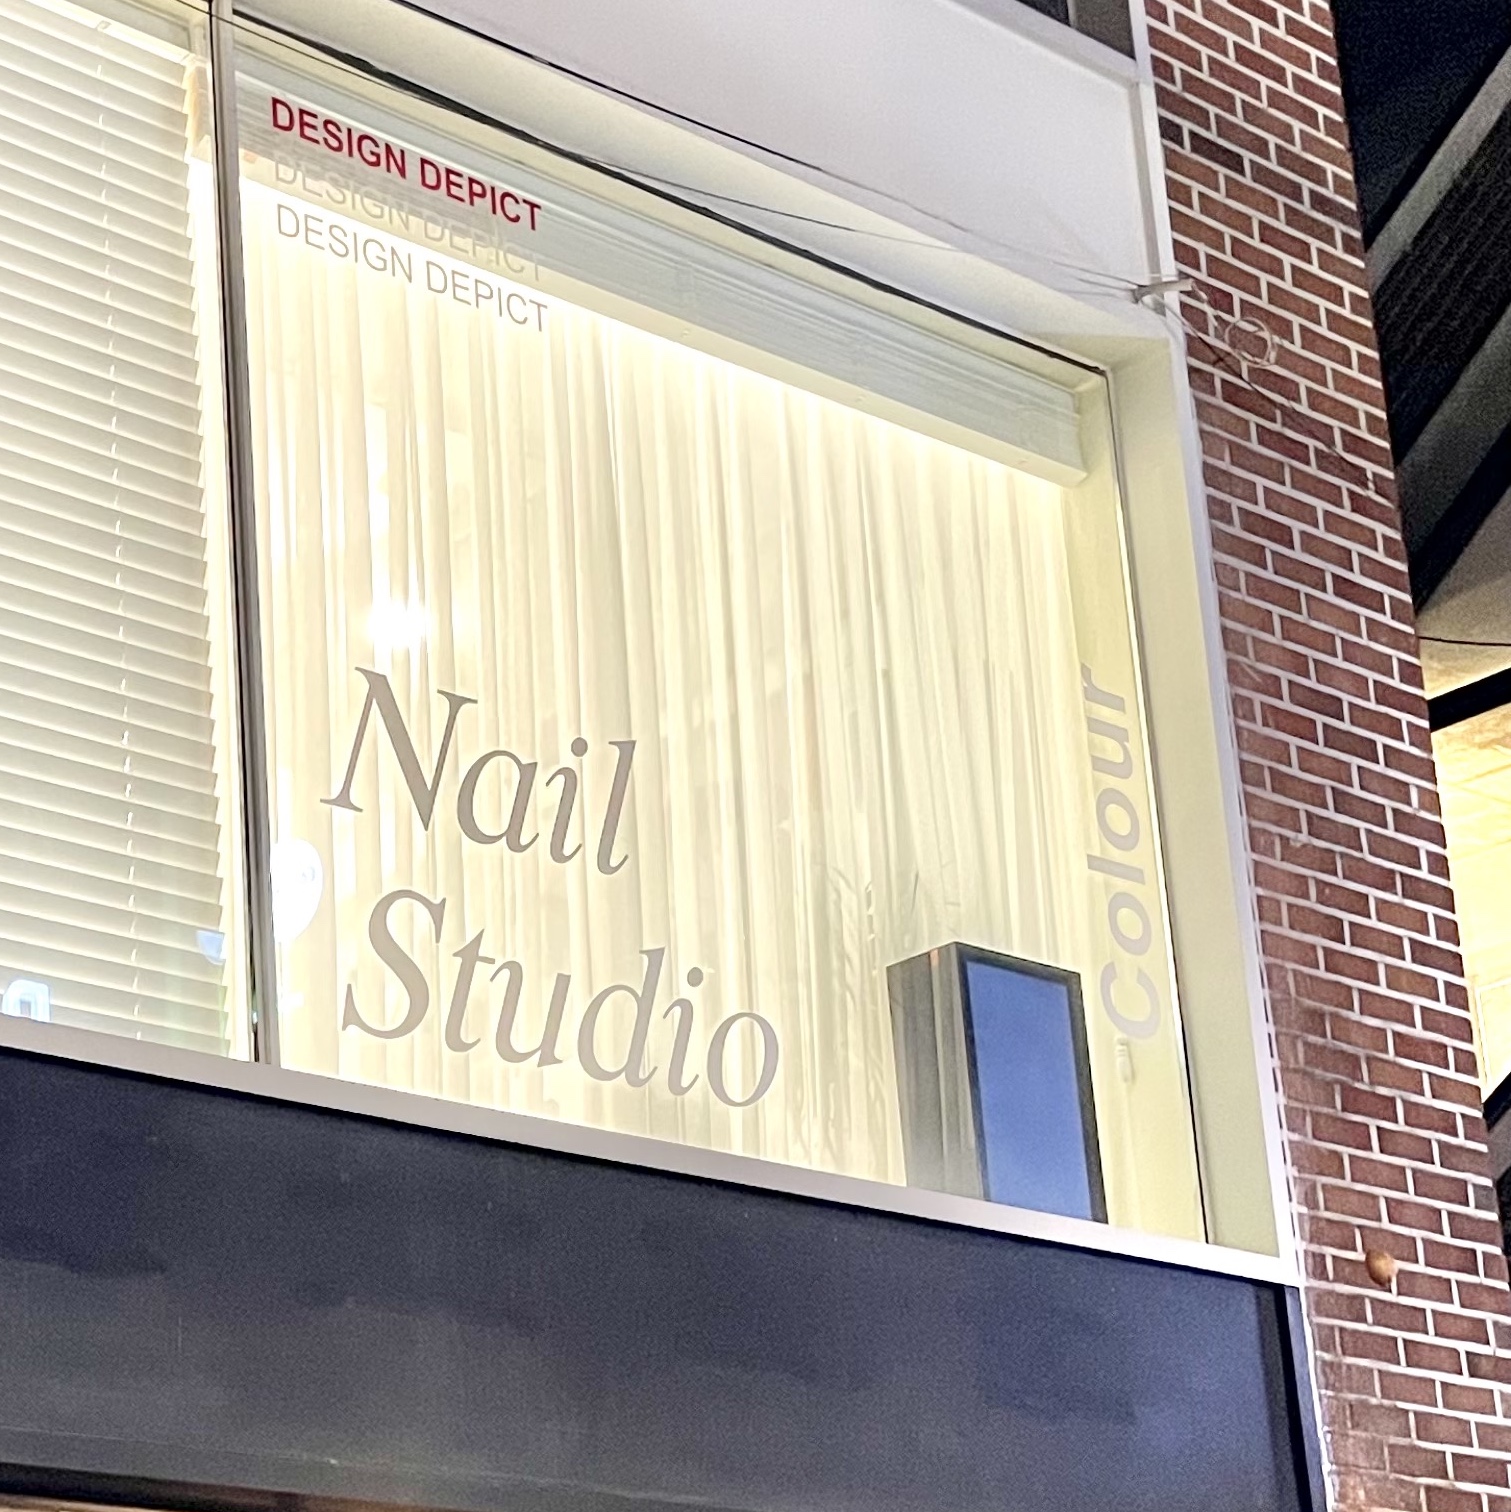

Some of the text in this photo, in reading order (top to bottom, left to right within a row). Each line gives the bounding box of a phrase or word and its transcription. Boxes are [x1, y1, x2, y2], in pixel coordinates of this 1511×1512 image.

[270, 96, 541, 230] DESIGN DEPICT
[276, 204, 548, 332] DESIGN DEPICT
[320, 666, 637, 875] Nail
[1081, 662, 1160, 1041] Colour
[343, 889, 779, 1107] Studio
